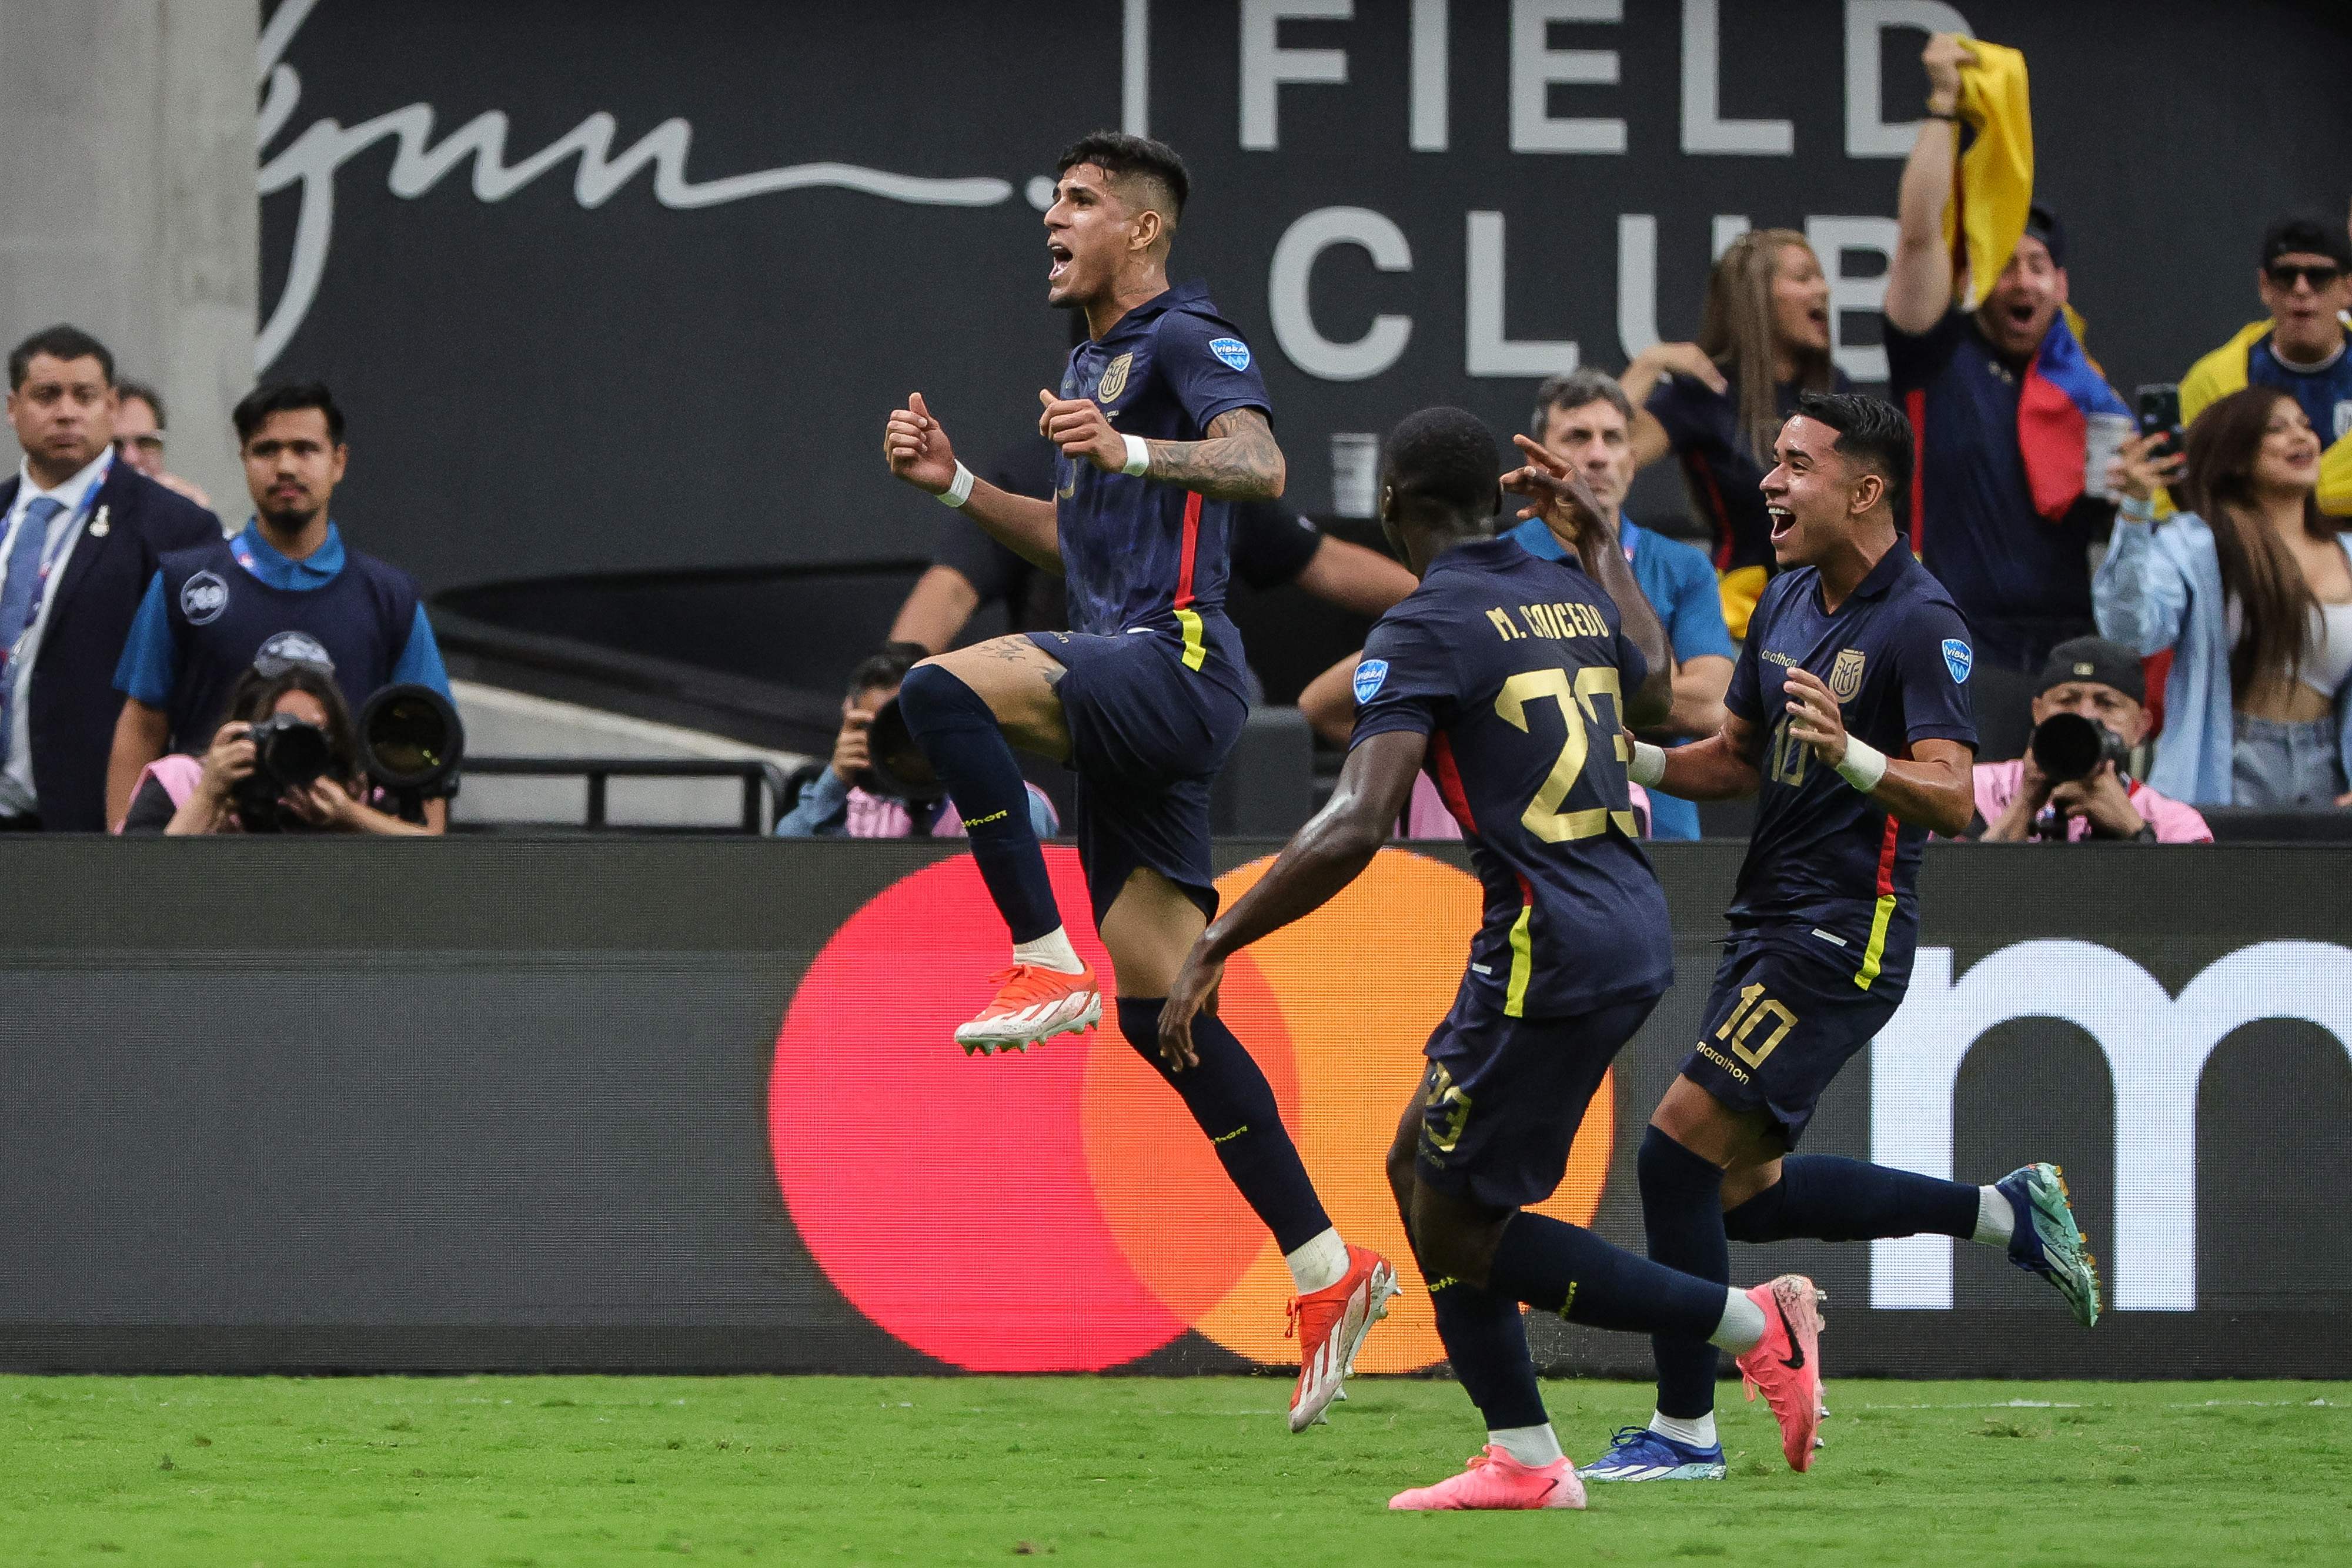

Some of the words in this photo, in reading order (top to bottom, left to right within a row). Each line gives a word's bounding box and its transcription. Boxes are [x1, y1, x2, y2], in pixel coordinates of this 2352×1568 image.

[1239, 0, 1977, 159] FIELD
[1485, 607, 1527, 641] M.
[1519, 603, 1609, 640] CAICEDO
[1947, 648, 1969, 662] VIBRA
[1494, 667, 1639, 844] 23
[1715, 982, 1799, 1070] 10
[1696, 1040, 1750, 1086] marathon
